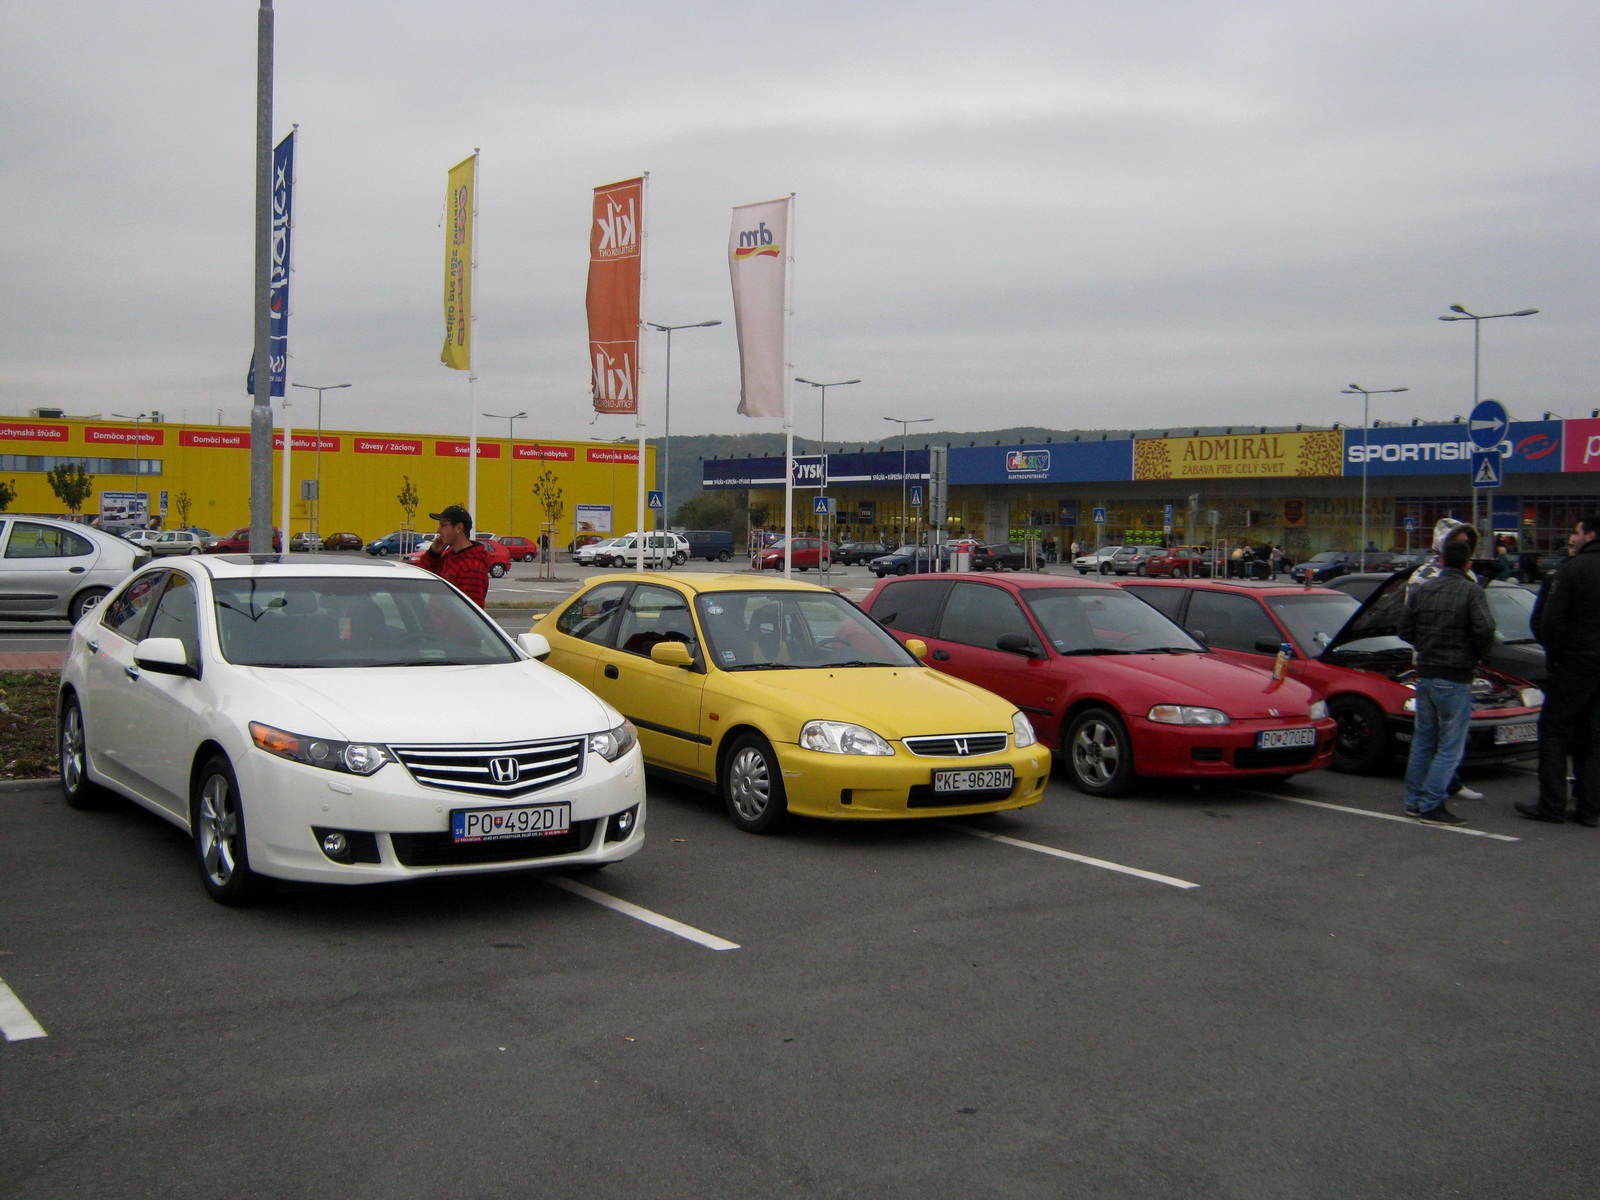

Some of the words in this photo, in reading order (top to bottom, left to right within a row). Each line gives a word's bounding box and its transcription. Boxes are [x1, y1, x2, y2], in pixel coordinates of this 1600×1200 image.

[37, 429, 61, 437] štúdio
[93, 431, 124, 440] Domáce
[193, 435, 221, 444] Domáci
[222, 436, 240, 444] textil
[361, 442, 383, 451] Závesy
[390, 443, 416, 452] Záclony
[455, 446, 481, 454] Svietá
[1183, 437, 1286, 461] ADMIRAL
[544, 451, 569, 459] nábytok
[797, 464, 824, 479] JYSK
[1182, 463, 1213, 475] ZÁBAVA
[1216, 464, 1233, 474] PRE
[1235, 462, 1258, 474] CELÝ
[1260, 463, 1285, 473] SVET
[1264, 732, 1277, 747] PO
[944, 771, 1011, 790] KE-962BM
[467, 814, 493, 836] PO
[505, 808, 563, 832] 492DI
